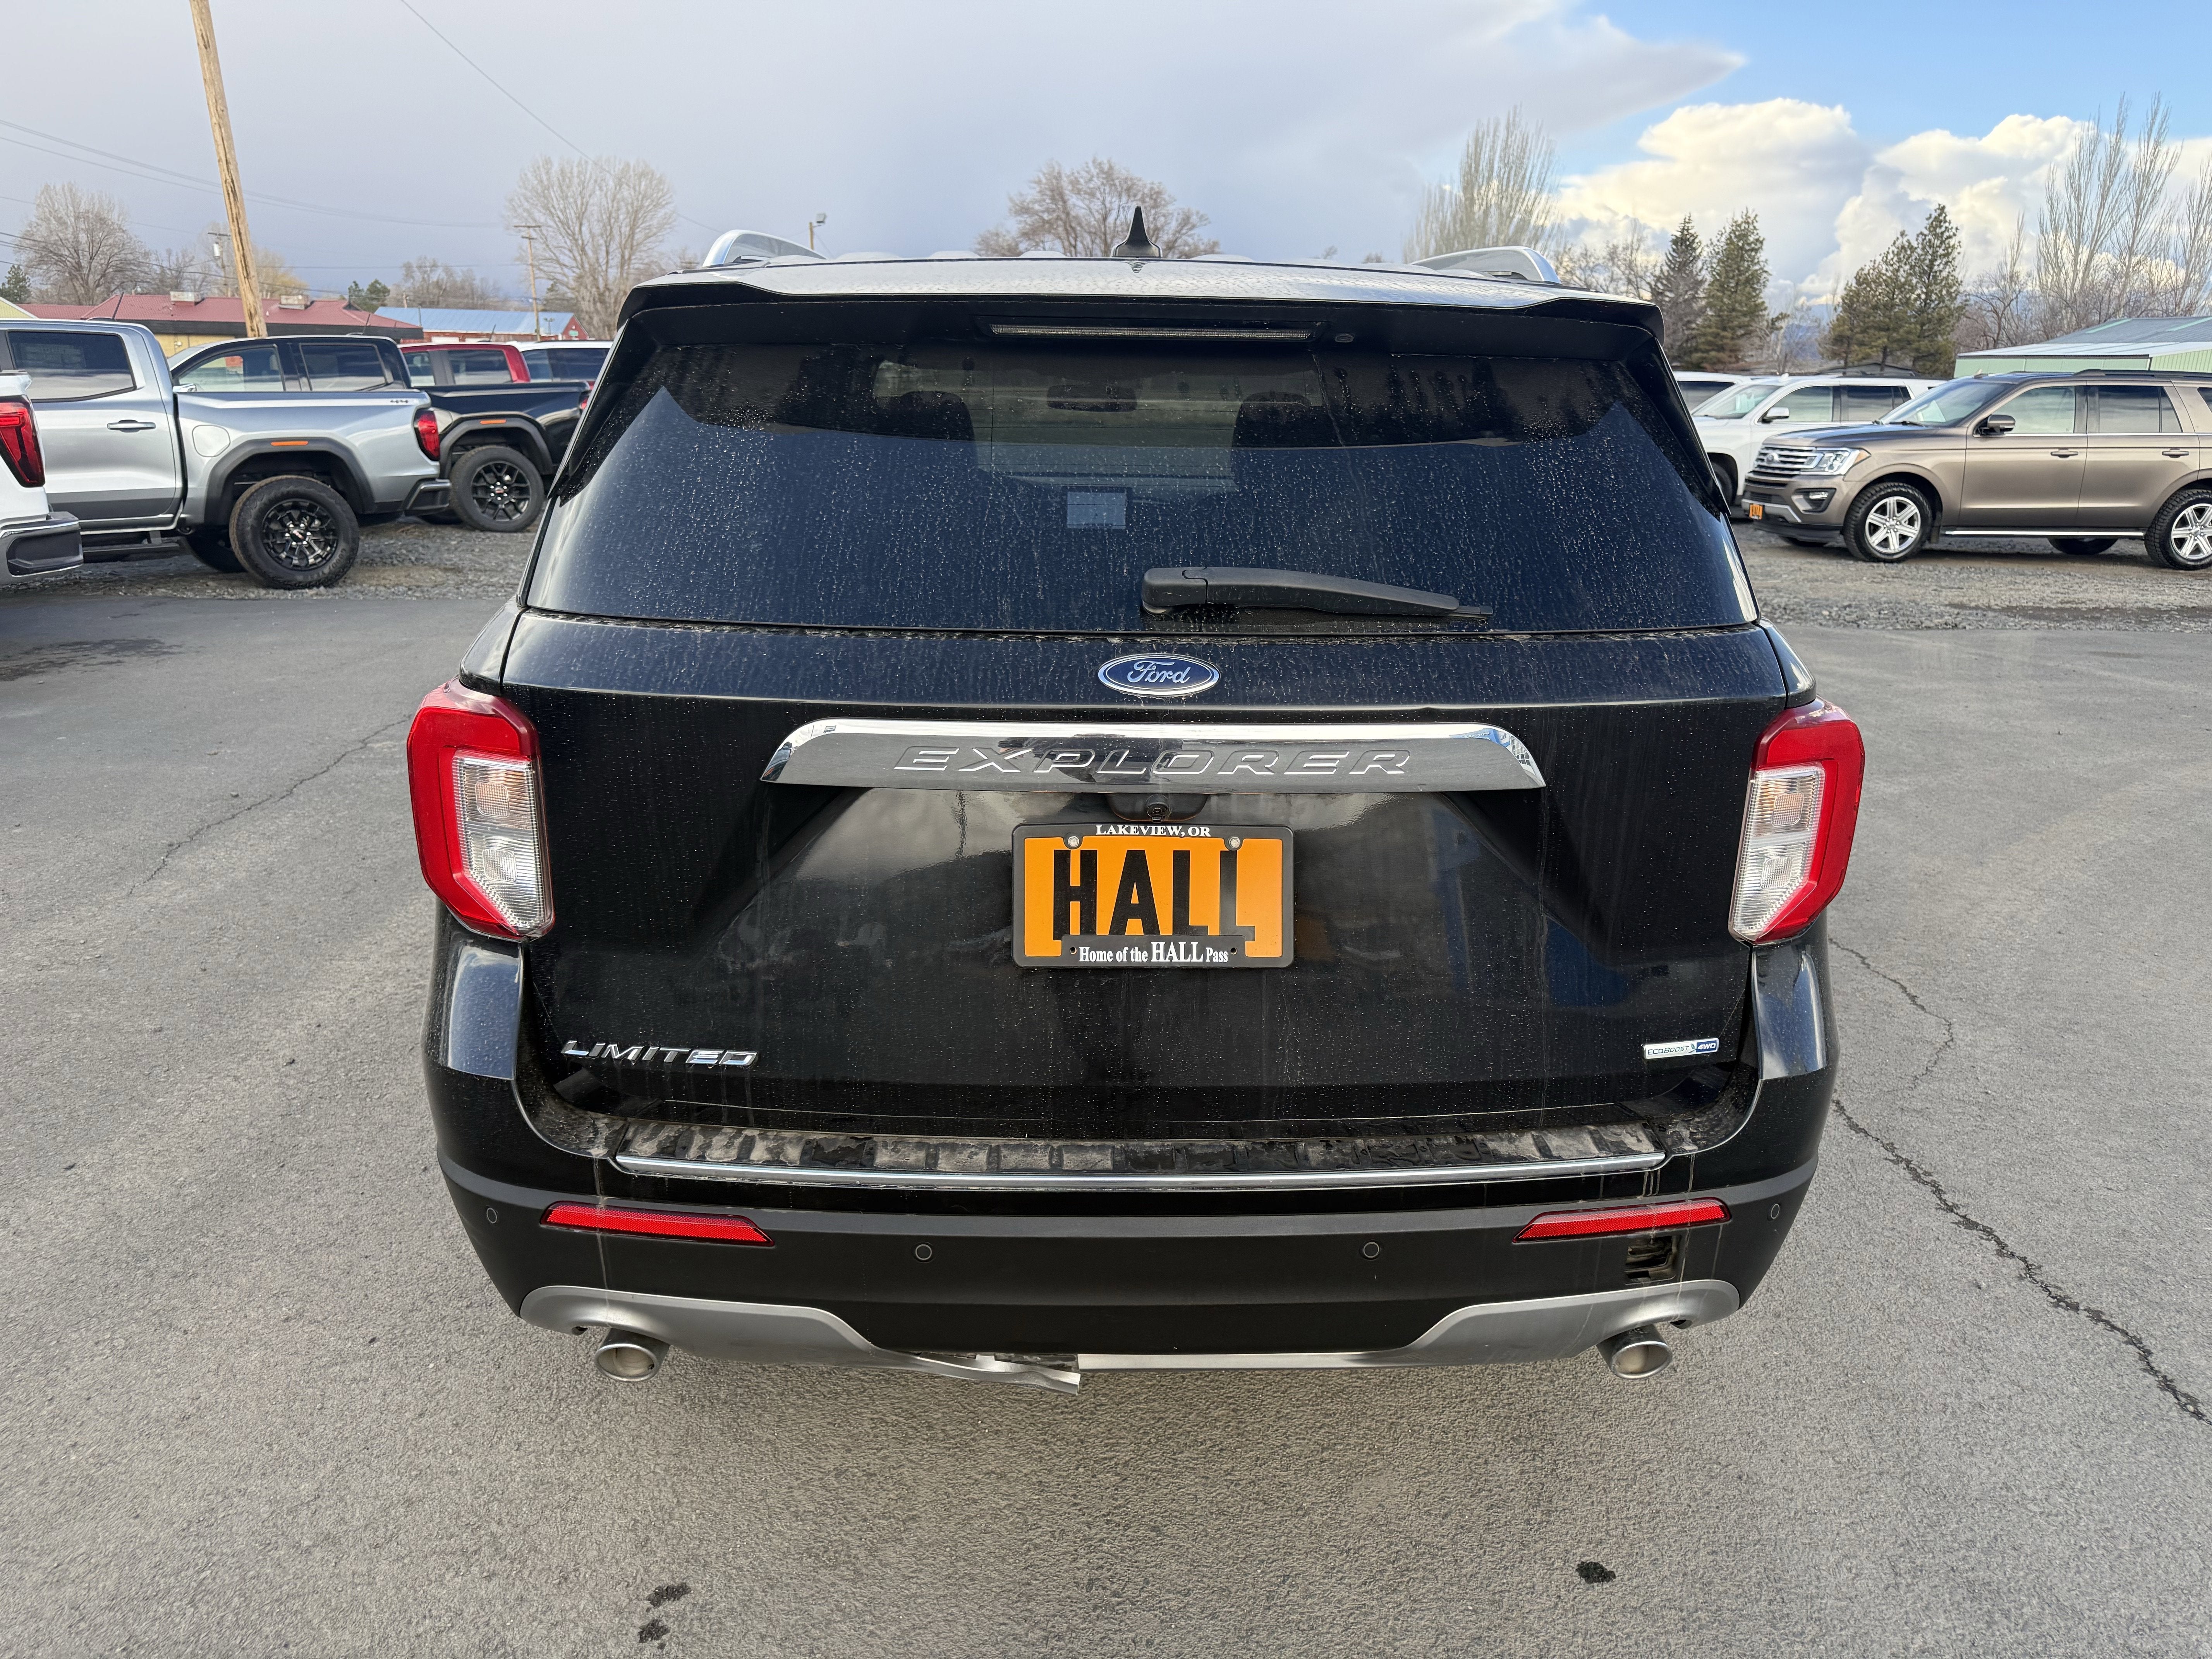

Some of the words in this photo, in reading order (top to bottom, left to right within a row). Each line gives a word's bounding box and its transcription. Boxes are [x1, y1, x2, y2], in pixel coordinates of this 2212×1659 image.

[1127, 661, 1191, 683] Ford
[894, 746, 1410, 775] EXPLORER
[1096, 825, 1185, 837] LAKEVIEW,
[1188, 826, 1211, 837] OR
[1053, 850, 1255, 942] HALL
[1079, 947, 1113, 962] Home
[1116, 947, 1129, 962] of
[1130, 947, 1148, 962] the
[1151, 942, 1203, 962] HALL
[1205, 947, 1228, 962] Pass
[561, 1040, 757, 1066] LIMITED
